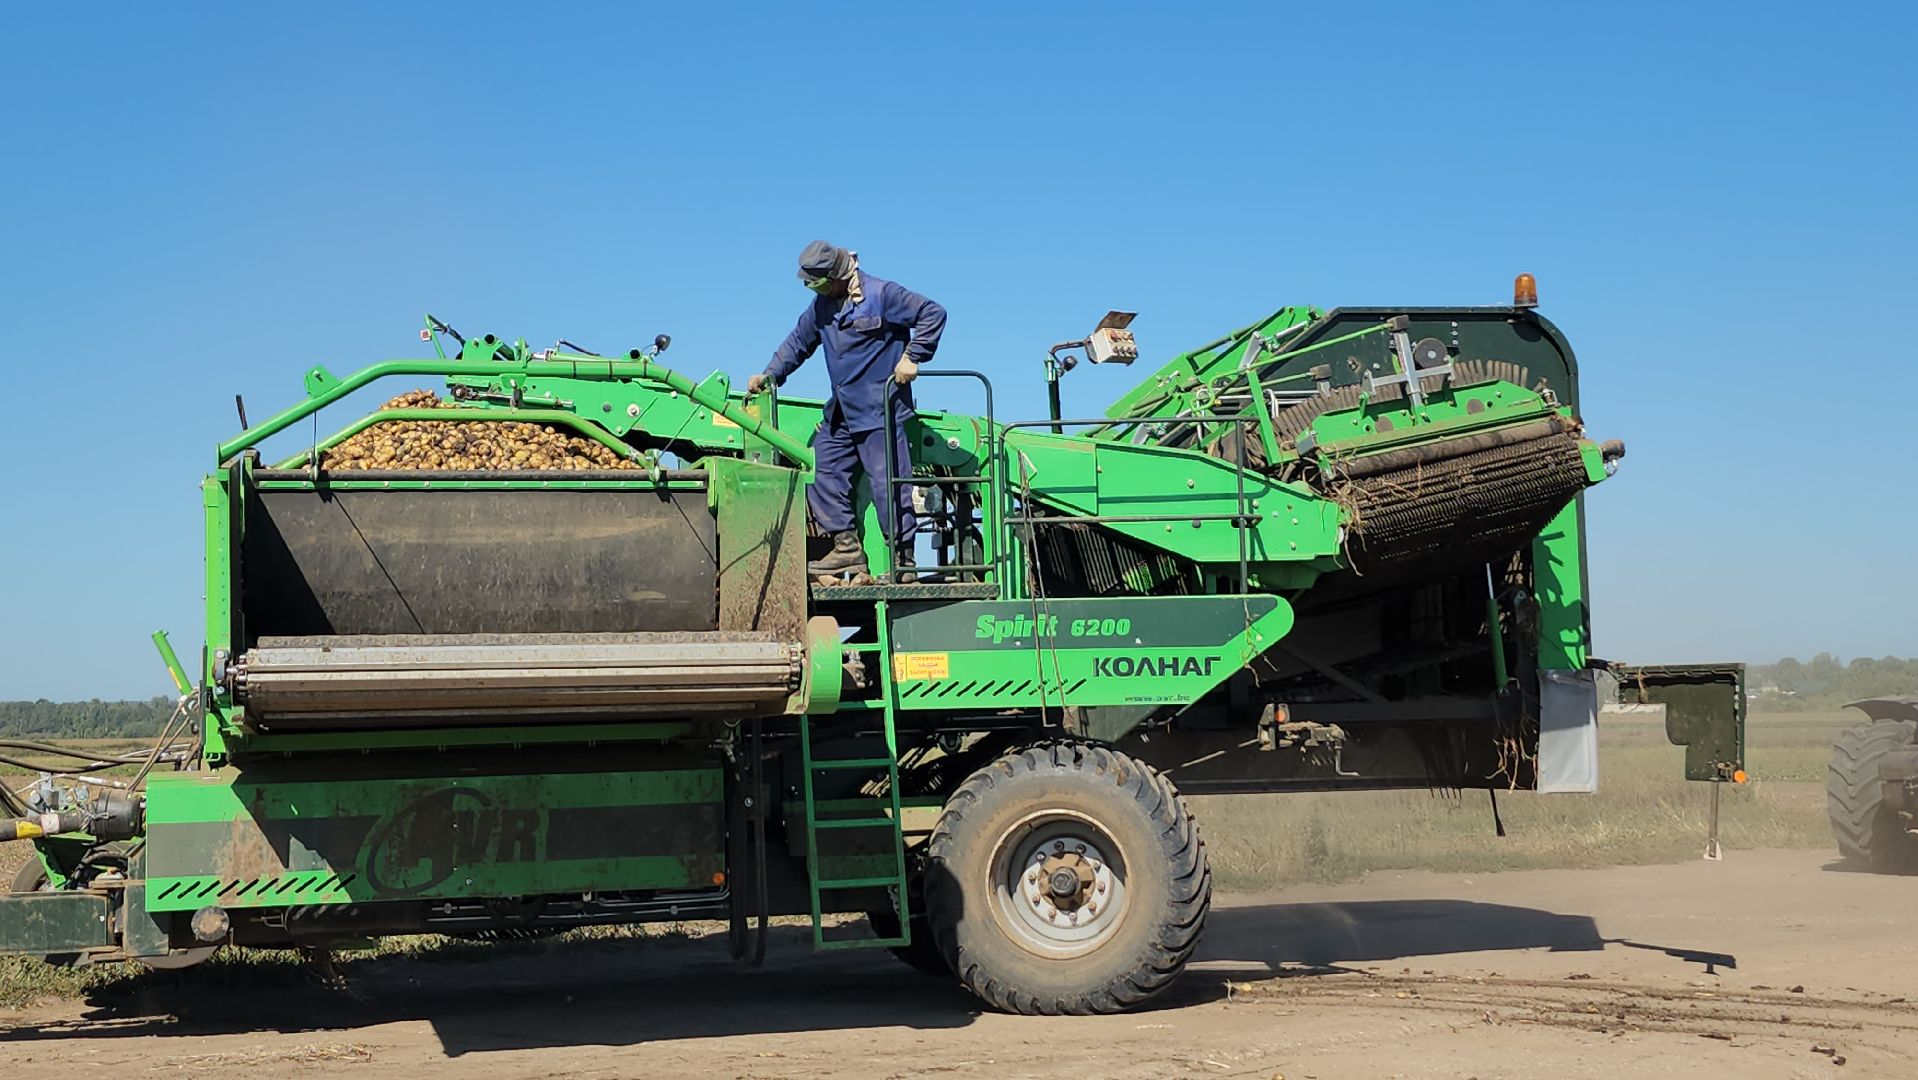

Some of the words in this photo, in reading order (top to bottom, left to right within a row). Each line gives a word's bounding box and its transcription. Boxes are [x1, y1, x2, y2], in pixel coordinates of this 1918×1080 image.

[975, 613, 1058, 644] Spirit
[1070, 618, 1131, 637] 6200
[1093, 656, 1221, 677] КОЛНАГ
